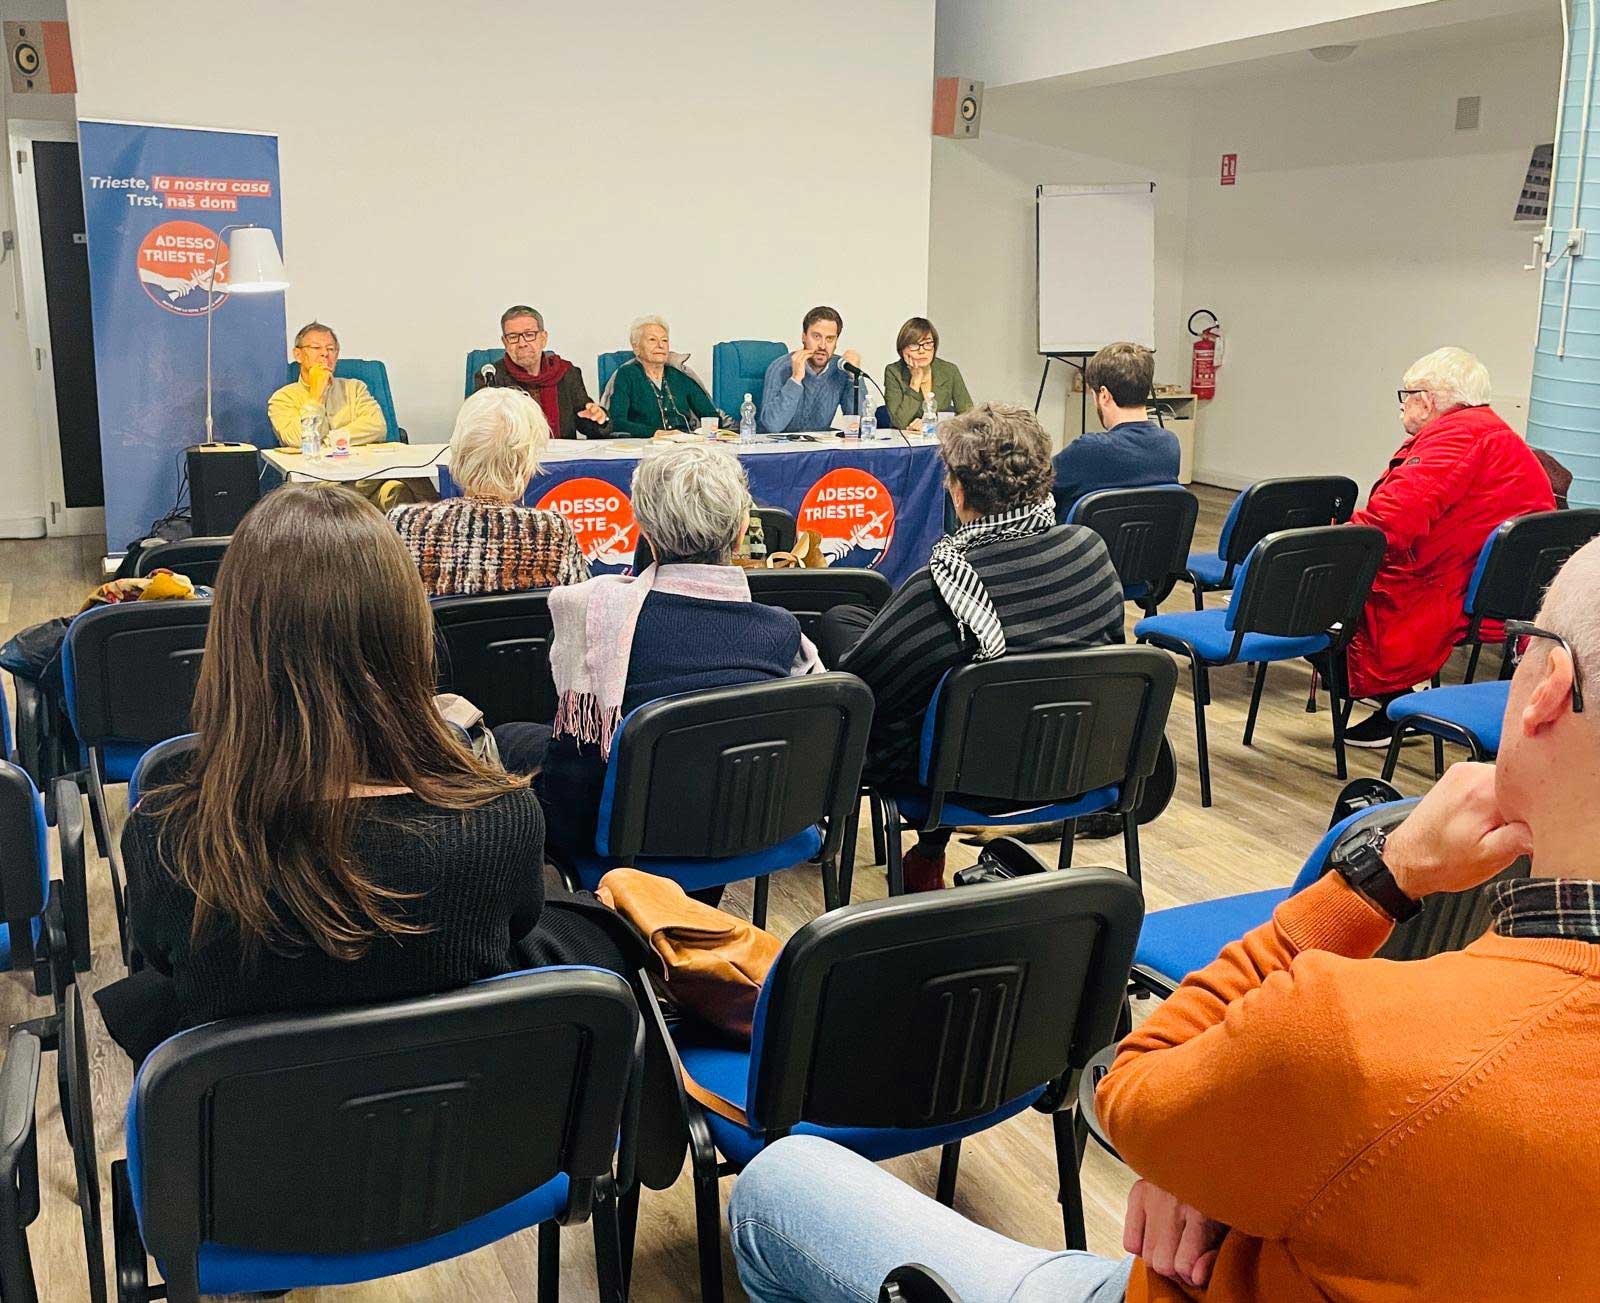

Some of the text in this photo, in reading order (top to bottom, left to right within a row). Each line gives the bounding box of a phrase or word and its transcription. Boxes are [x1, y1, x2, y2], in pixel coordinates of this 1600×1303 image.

[90, 176, 270, 193] Trieste, la nostra casa
[126, 193, 237, 209] Trst, naš dom
[155, 235, 216, 250] ADESSO
[143, 249, 206, 263] TRIESTE
[816, 485, 878, 502] ADESSO
[548, 496, 620, 515] ADESSO
[804, 503, 865, 522] TRIESTE
